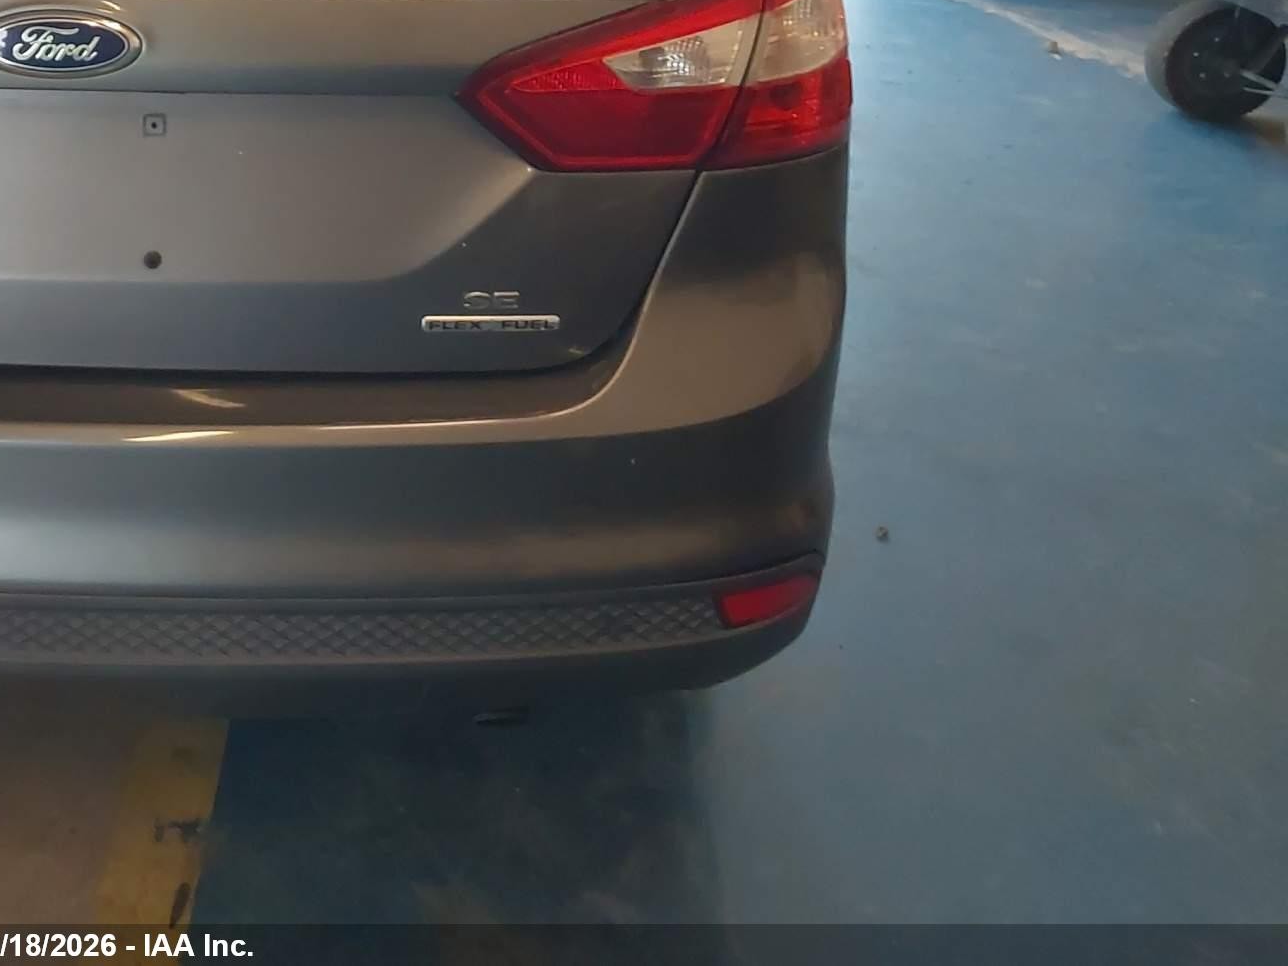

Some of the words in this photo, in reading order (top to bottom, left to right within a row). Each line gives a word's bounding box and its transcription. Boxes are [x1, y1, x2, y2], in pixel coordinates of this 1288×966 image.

[12, 25, 101, 62] Ford
[463, 291, 520, 309] SE
[428, 320, 481, 330] FLEX
[502, 320, 557, 330] FUEL
